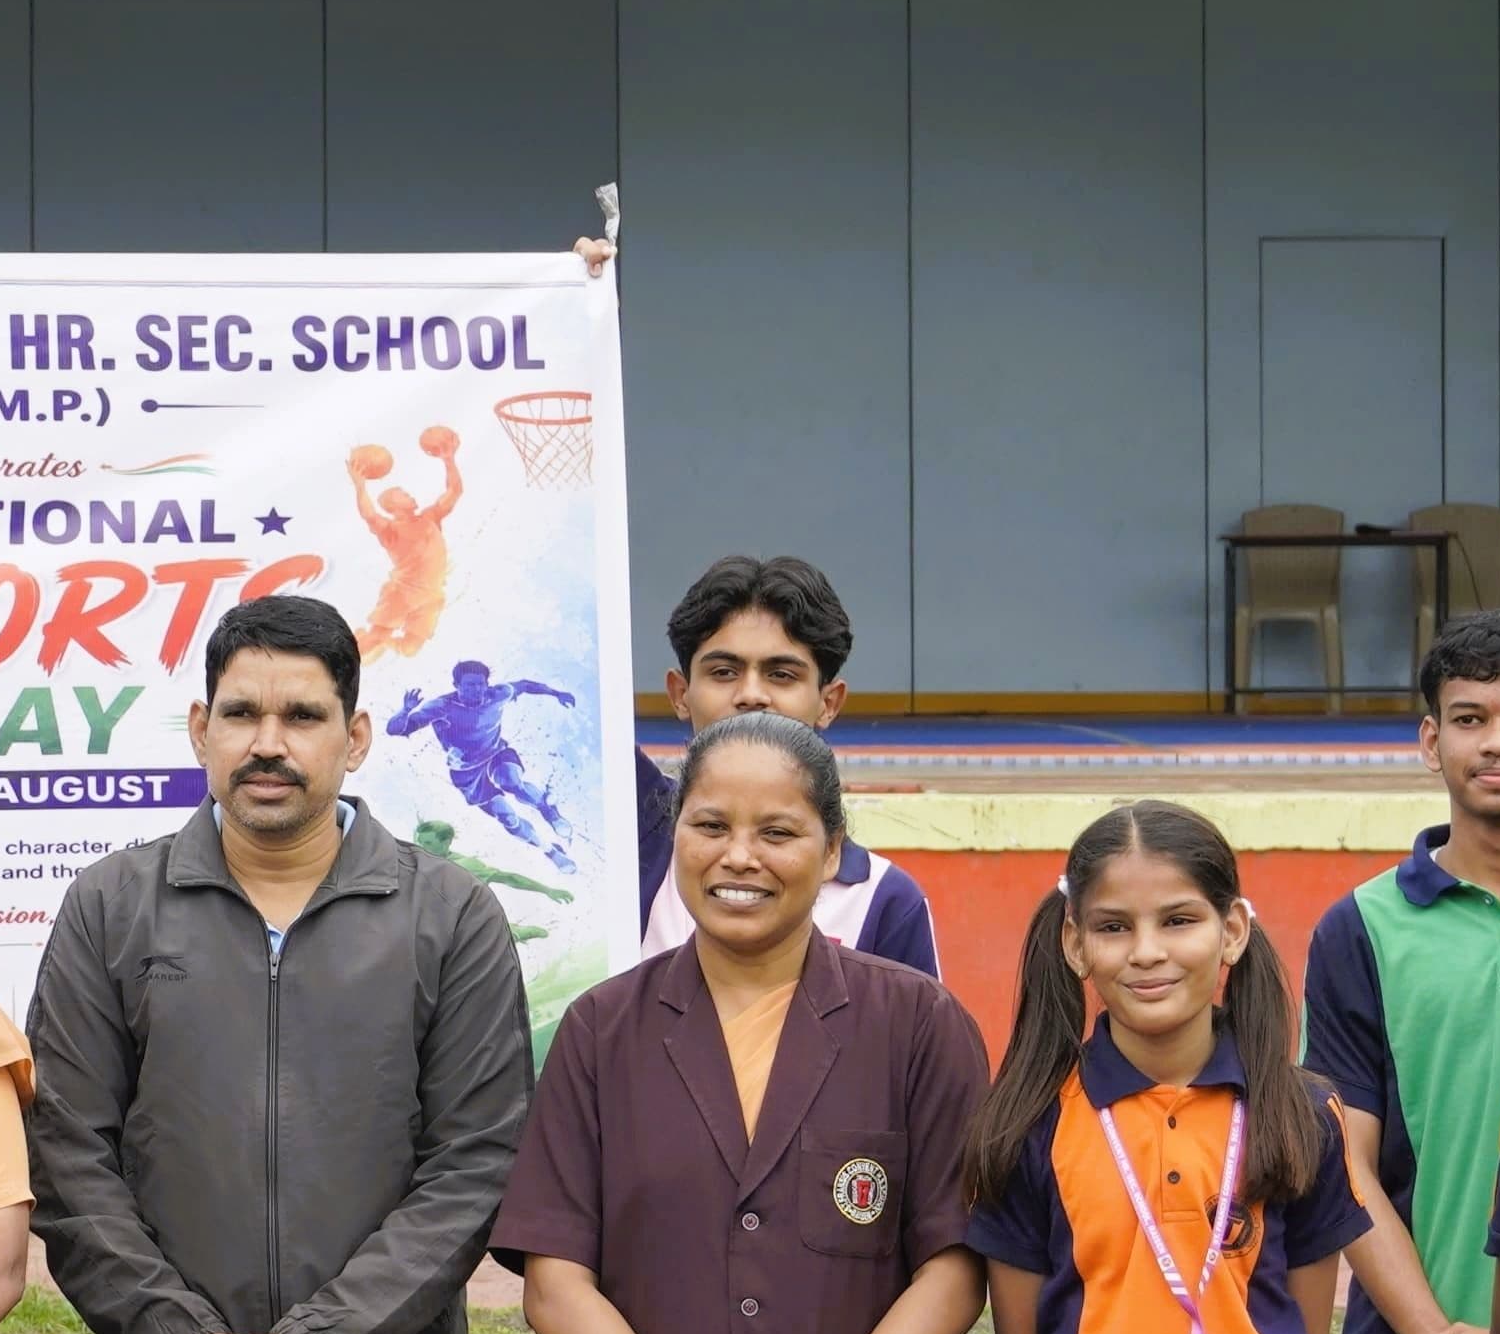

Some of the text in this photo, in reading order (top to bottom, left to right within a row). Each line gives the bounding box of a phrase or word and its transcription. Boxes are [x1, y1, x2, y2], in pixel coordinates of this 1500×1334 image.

[10, 314, 116, 370] HR.
[136, 314, 272, 372] SEC.
[292, 315, 545, 371] SCHOOL
[2, 864, 43, 880] and
